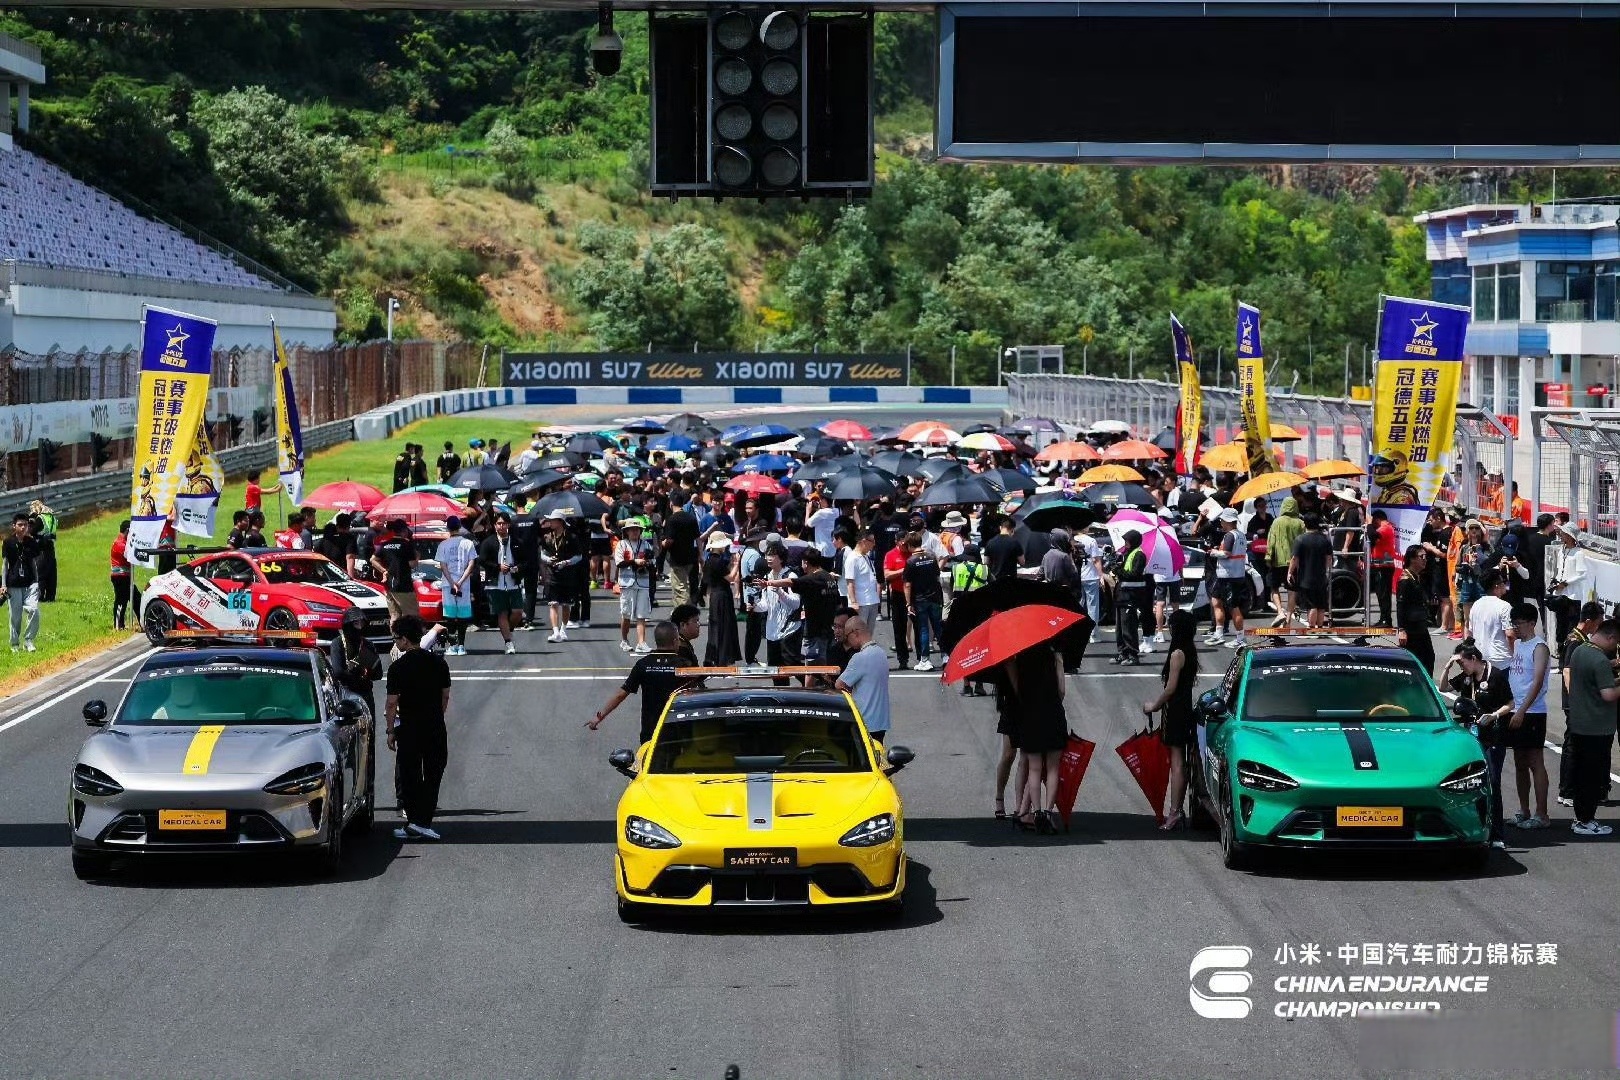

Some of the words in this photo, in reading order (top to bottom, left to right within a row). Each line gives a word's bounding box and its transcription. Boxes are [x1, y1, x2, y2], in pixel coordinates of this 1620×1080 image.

[602, 361, 642, 379] SU7
[646, 363, 704, 380] Ultra
[805, 361, 844, 379] SU7
[848, 363, 903, 379] Ultra
[149, 379, 166, 454] 冠德五星
[154, 379, 188, 474] 赛事级燃油
[1388, 368, 1415, 443] 冠德五星
[1409, 368, 1440, 463] 赛事级燃油
[260, 562, 282, 573] 66
[233, 594, 247, 609] 66
[730, 857, 768, 865] SAFETY
